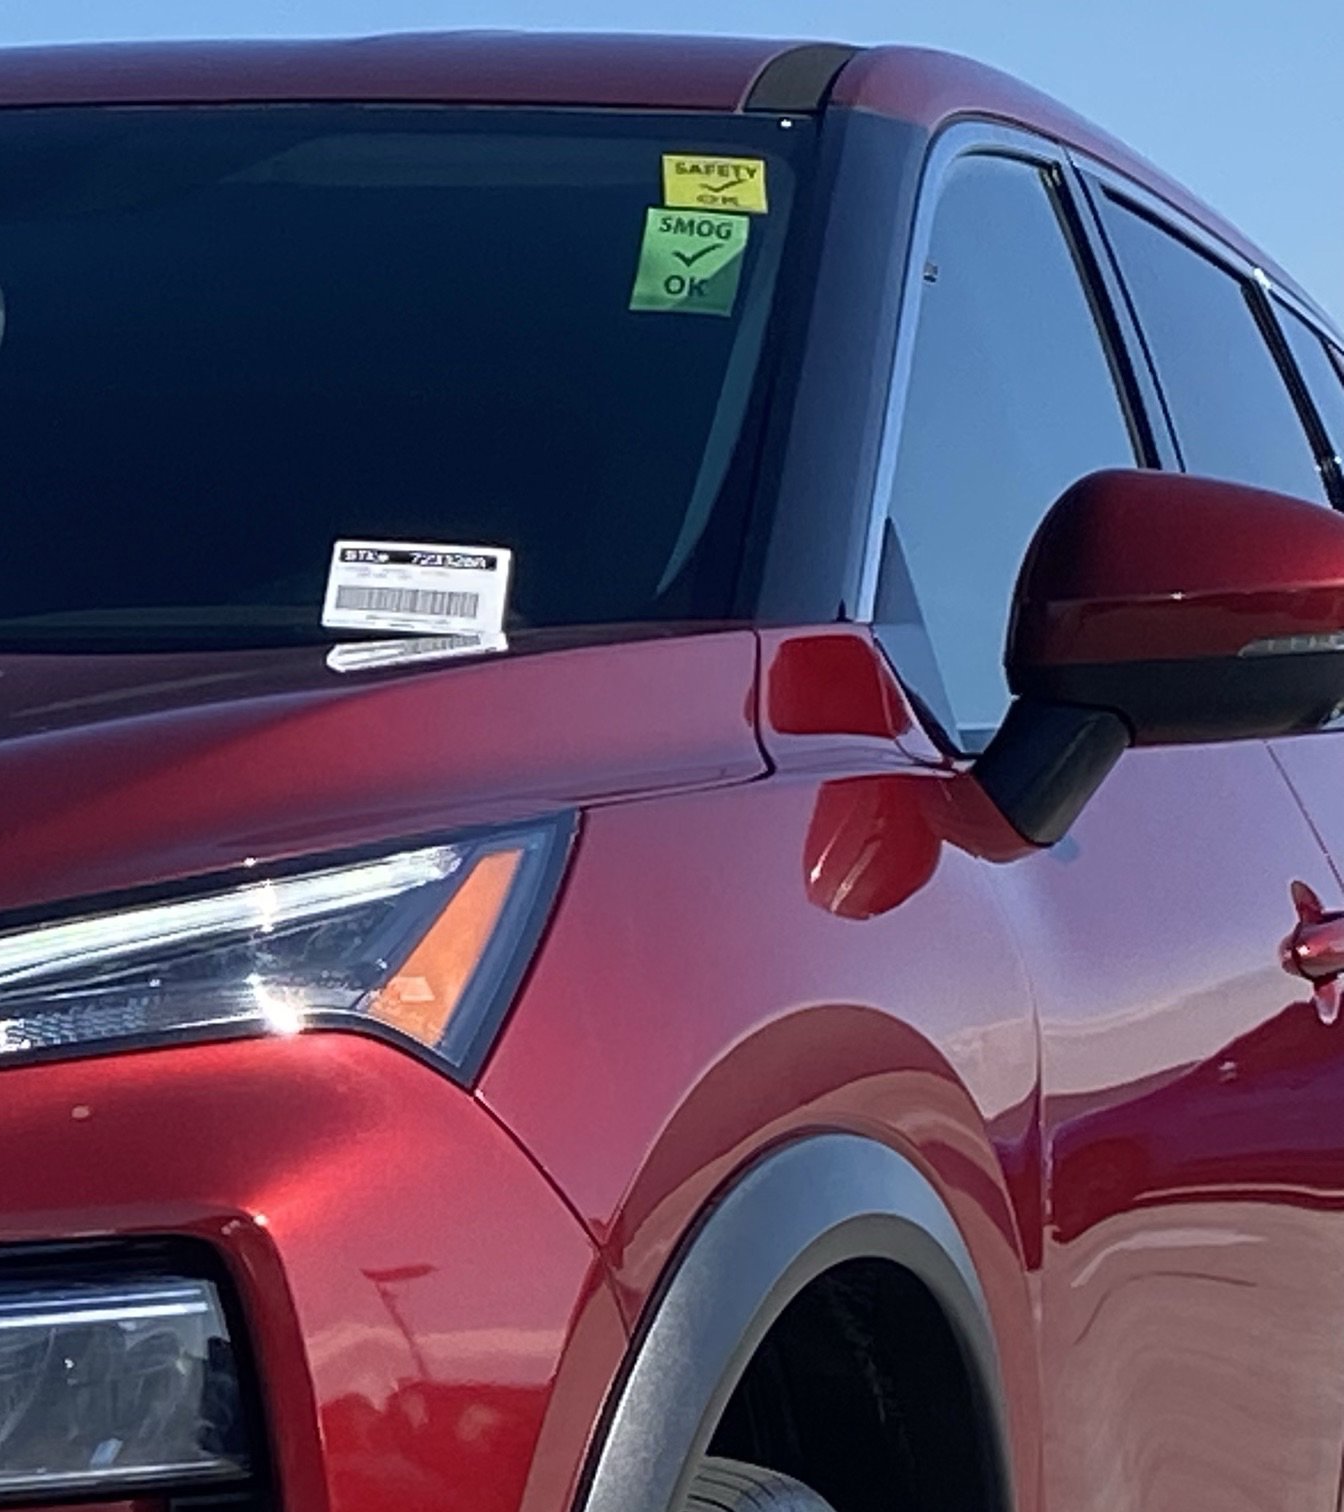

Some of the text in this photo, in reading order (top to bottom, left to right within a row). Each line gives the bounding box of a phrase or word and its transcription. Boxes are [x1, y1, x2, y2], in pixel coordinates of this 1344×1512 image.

[674, 161, 757, 180] SAFETY
[659, 216, 734, 240] SMOG
[663, 274, 710, 298] OK
